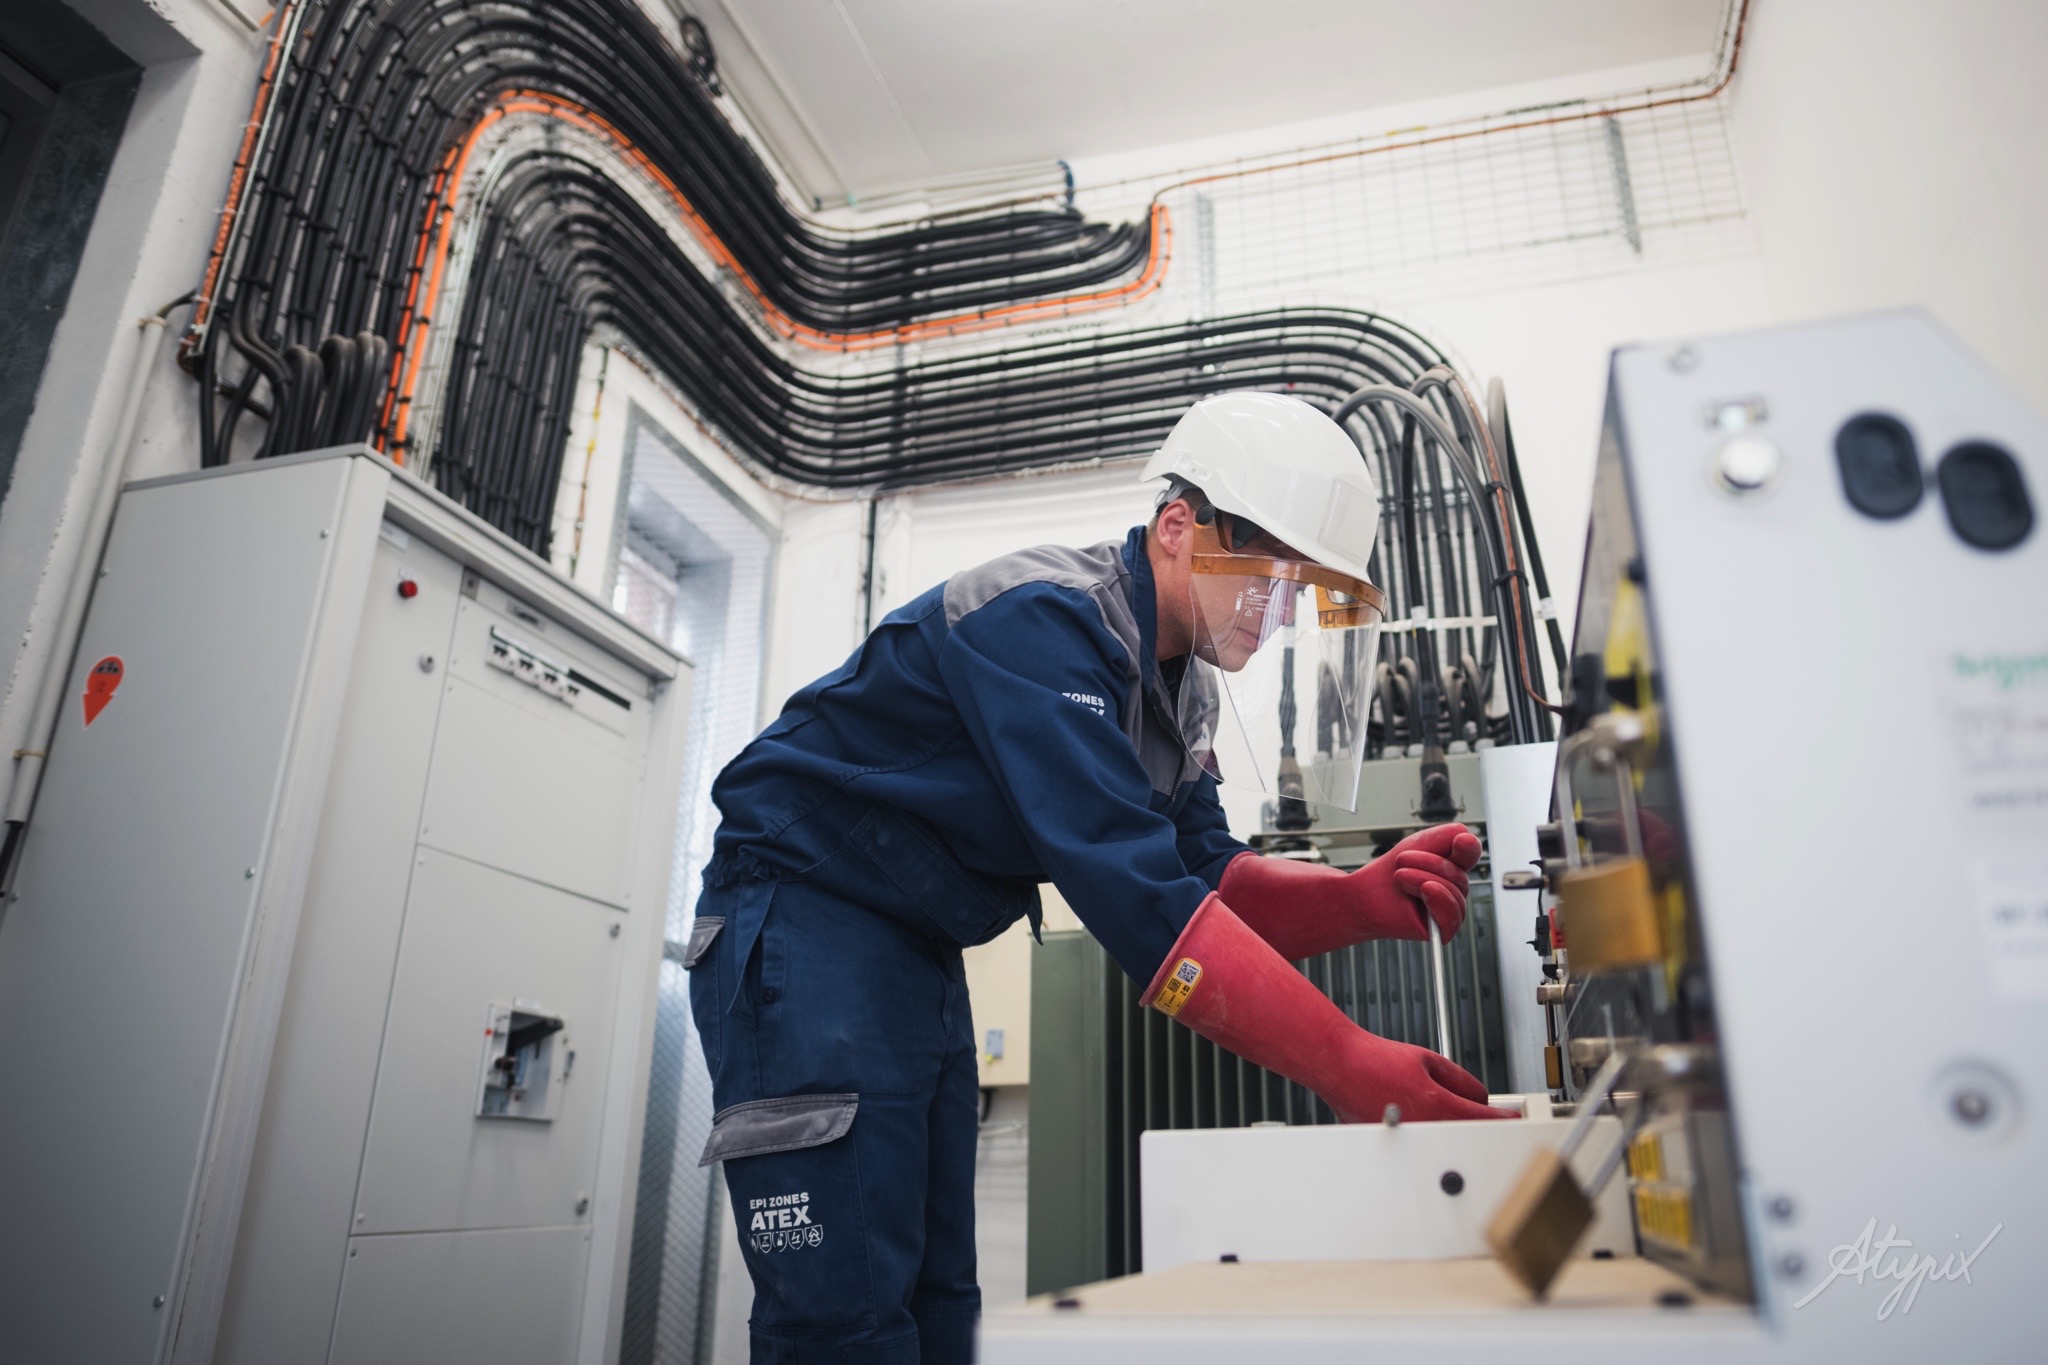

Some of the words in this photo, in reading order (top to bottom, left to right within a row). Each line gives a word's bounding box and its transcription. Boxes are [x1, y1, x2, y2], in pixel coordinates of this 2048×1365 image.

[750, 1198, 767, 1210] EPI
[769, 1192, 810, 1208] ZONES
[750, 1205, 812, 1231] ATEX
